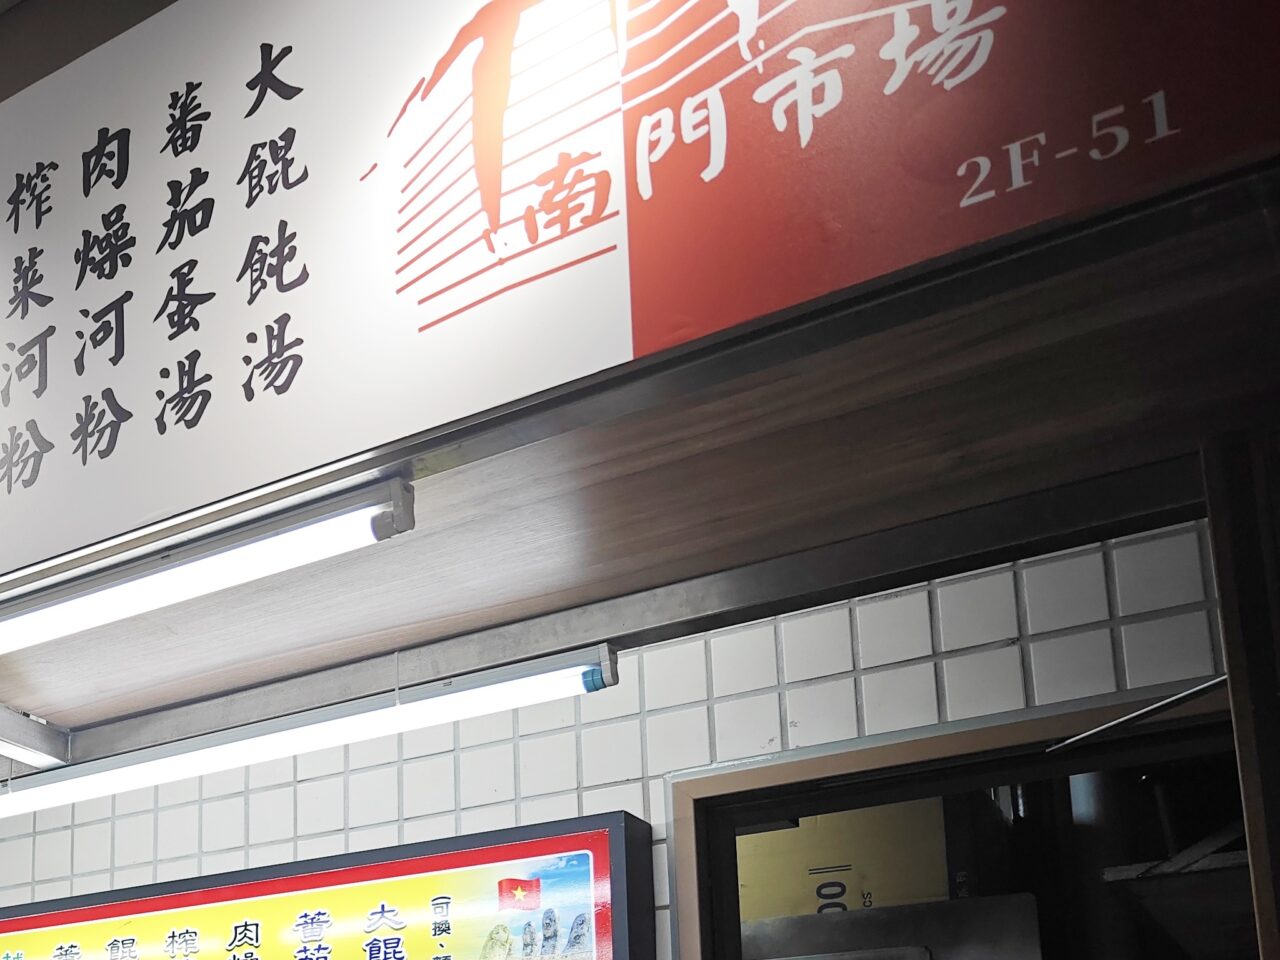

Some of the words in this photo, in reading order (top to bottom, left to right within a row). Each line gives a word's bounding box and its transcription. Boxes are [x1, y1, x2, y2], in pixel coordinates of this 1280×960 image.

[154, 82, 216, 435] 蕃茄蛋湯
[236, 43, 310, 402] 大餛飩湯
[523, 0, 1006, 244] 南門市場
[956, 88, 1181, 208] 2F-51
[71, 127, 137, 466] 肉燥河粉
